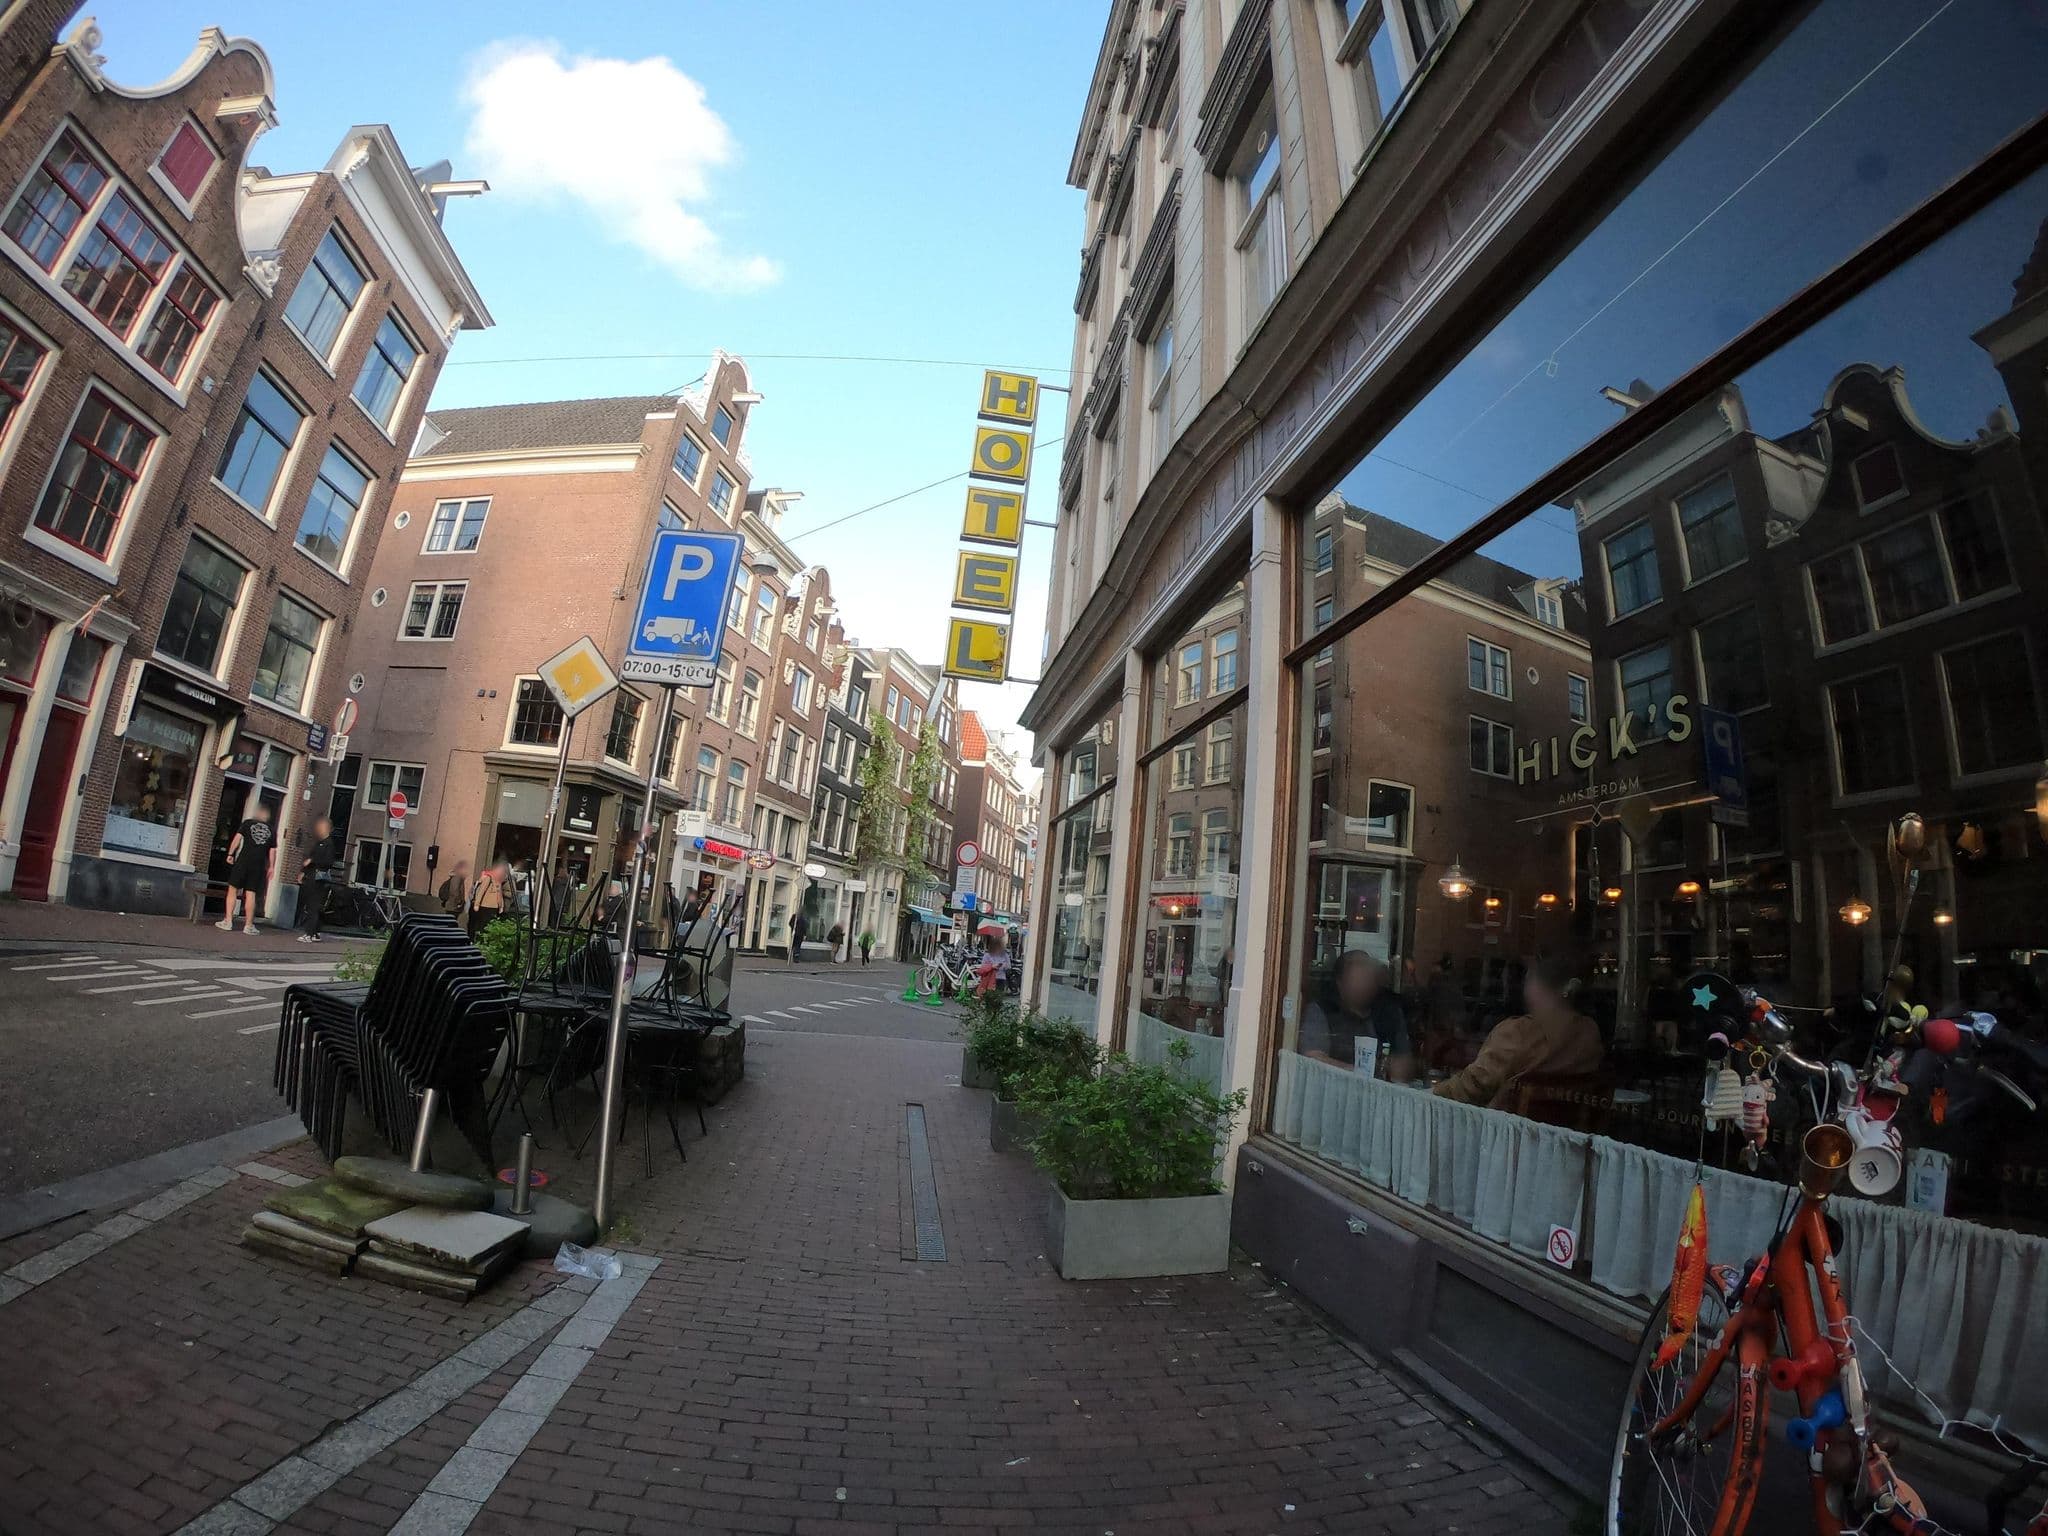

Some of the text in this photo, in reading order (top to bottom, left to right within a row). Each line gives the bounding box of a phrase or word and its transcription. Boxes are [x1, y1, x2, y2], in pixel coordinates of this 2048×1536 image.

[956, 376, 1030, 672] HOTEL
[662, 544, 714, 601] P
[120, 666, 140, 723] TATTOO
[1517, 694, 1692, 785] HICK'S
[1558, 775, 1641, 806] AMSTERDAM
[1657, 1109, 1737, 1136] BOURN
